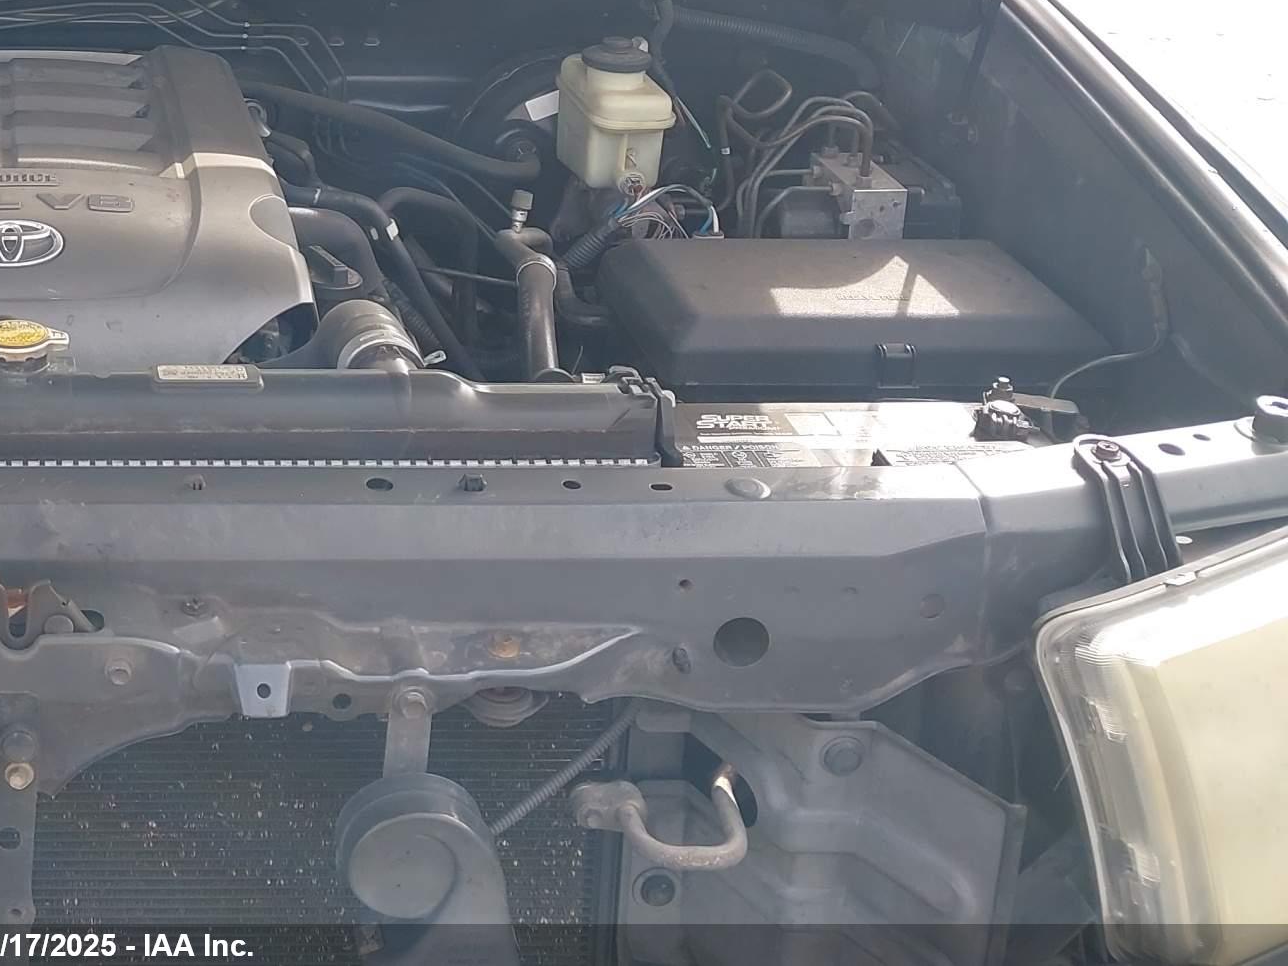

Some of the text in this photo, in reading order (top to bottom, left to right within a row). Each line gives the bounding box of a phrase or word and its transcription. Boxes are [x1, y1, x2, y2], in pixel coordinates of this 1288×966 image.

[35, 192, 136, 214] V8
[700, 413, 770, 423] SUPER
[696, 420, 773, 430] START
[691, 444, 733, 452] DANGER
